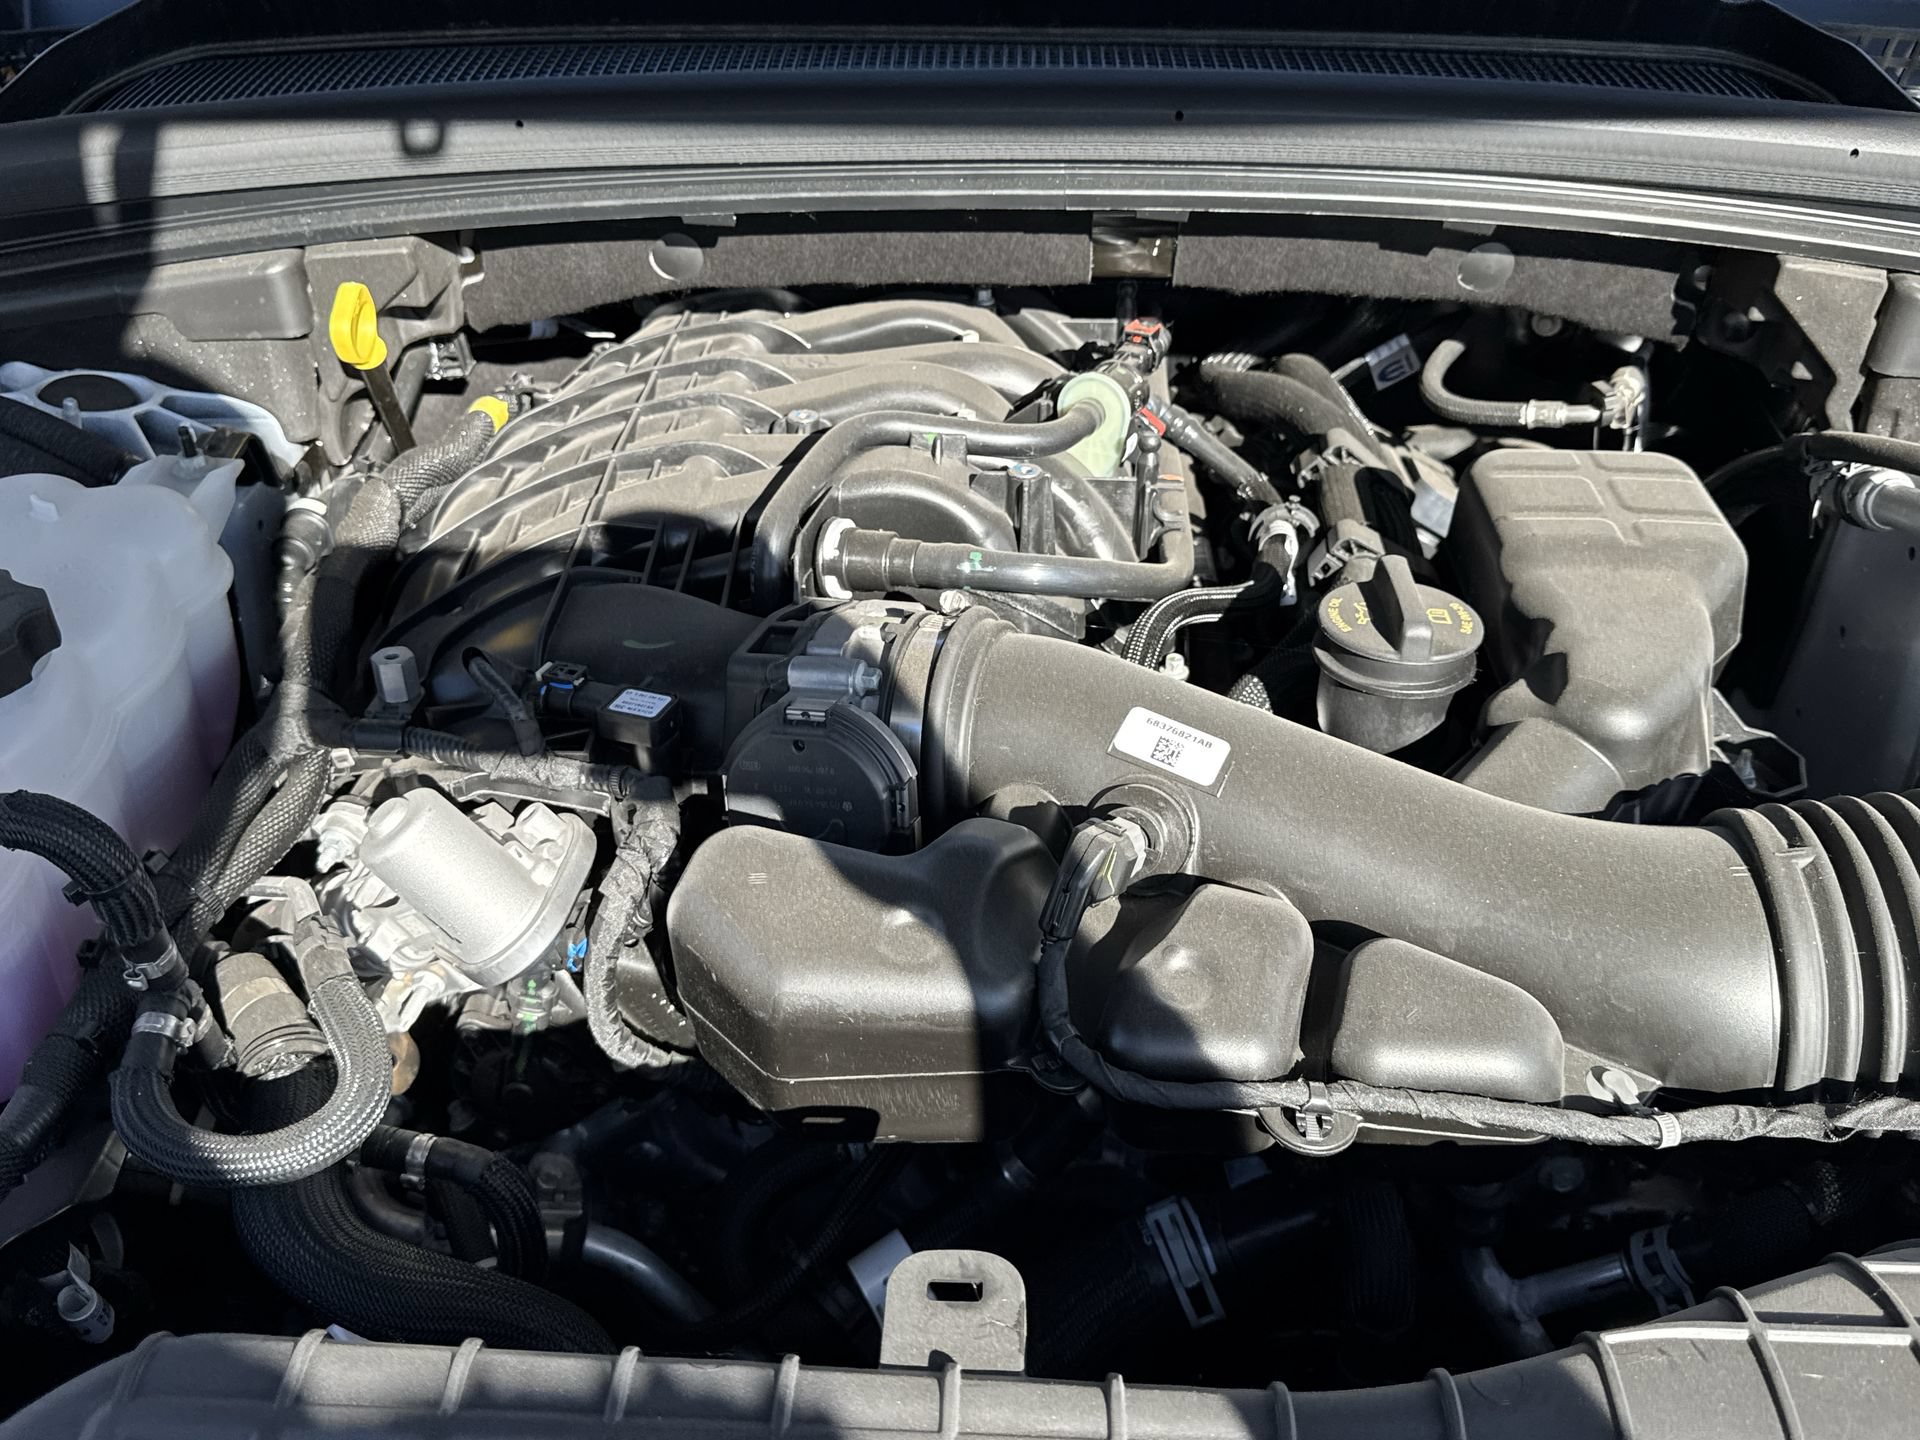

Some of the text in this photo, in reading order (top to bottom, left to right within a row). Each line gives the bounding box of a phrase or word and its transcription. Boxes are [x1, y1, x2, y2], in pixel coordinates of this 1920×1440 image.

[1328, 607, 1352, 632] ENGINE
[1460, 620, 1473, 634] SAE
[1146, 717, 1213, 749] 68376821AB
